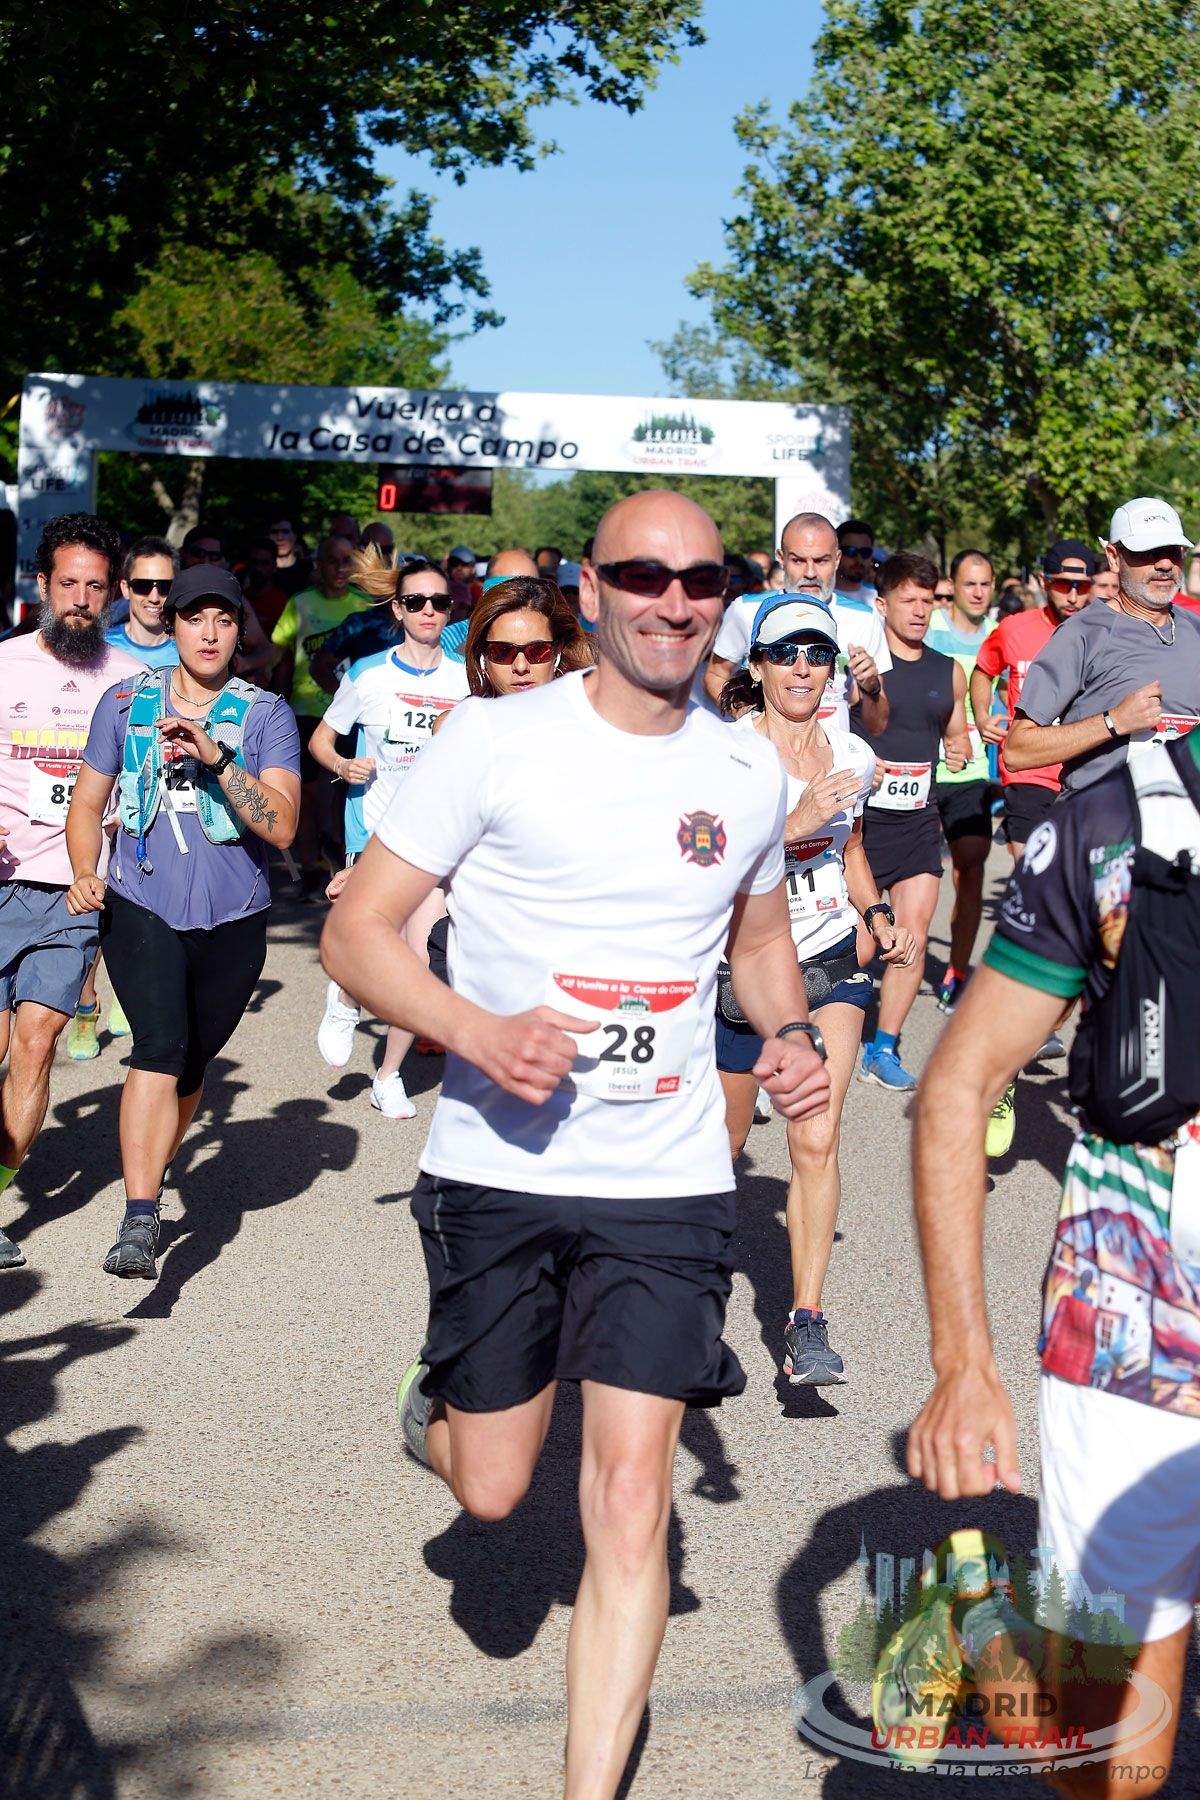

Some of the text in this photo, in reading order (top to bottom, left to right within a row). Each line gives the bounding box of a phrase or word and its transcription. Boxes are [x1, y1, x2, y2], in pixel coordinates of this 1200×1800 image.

[354, 395, 495, 422] Vuelta a
[268, 424, 578, 464] la Casa de Campo
[645, 446, 698, 456] MADRID
[772, 449, 809, 461] LIFE
[380, 484, 397, 511] 0
[887, 781, 919, 796] 640
[808, 840, 829, 848] Campo
[576, 979, 609, 991] Vuelta
[633, 985, 657, 994] Casa
[657, 985, 669, 994] de
[669, 985, 694, 995] Campo
[599, 1023, 656, 1064] 28
